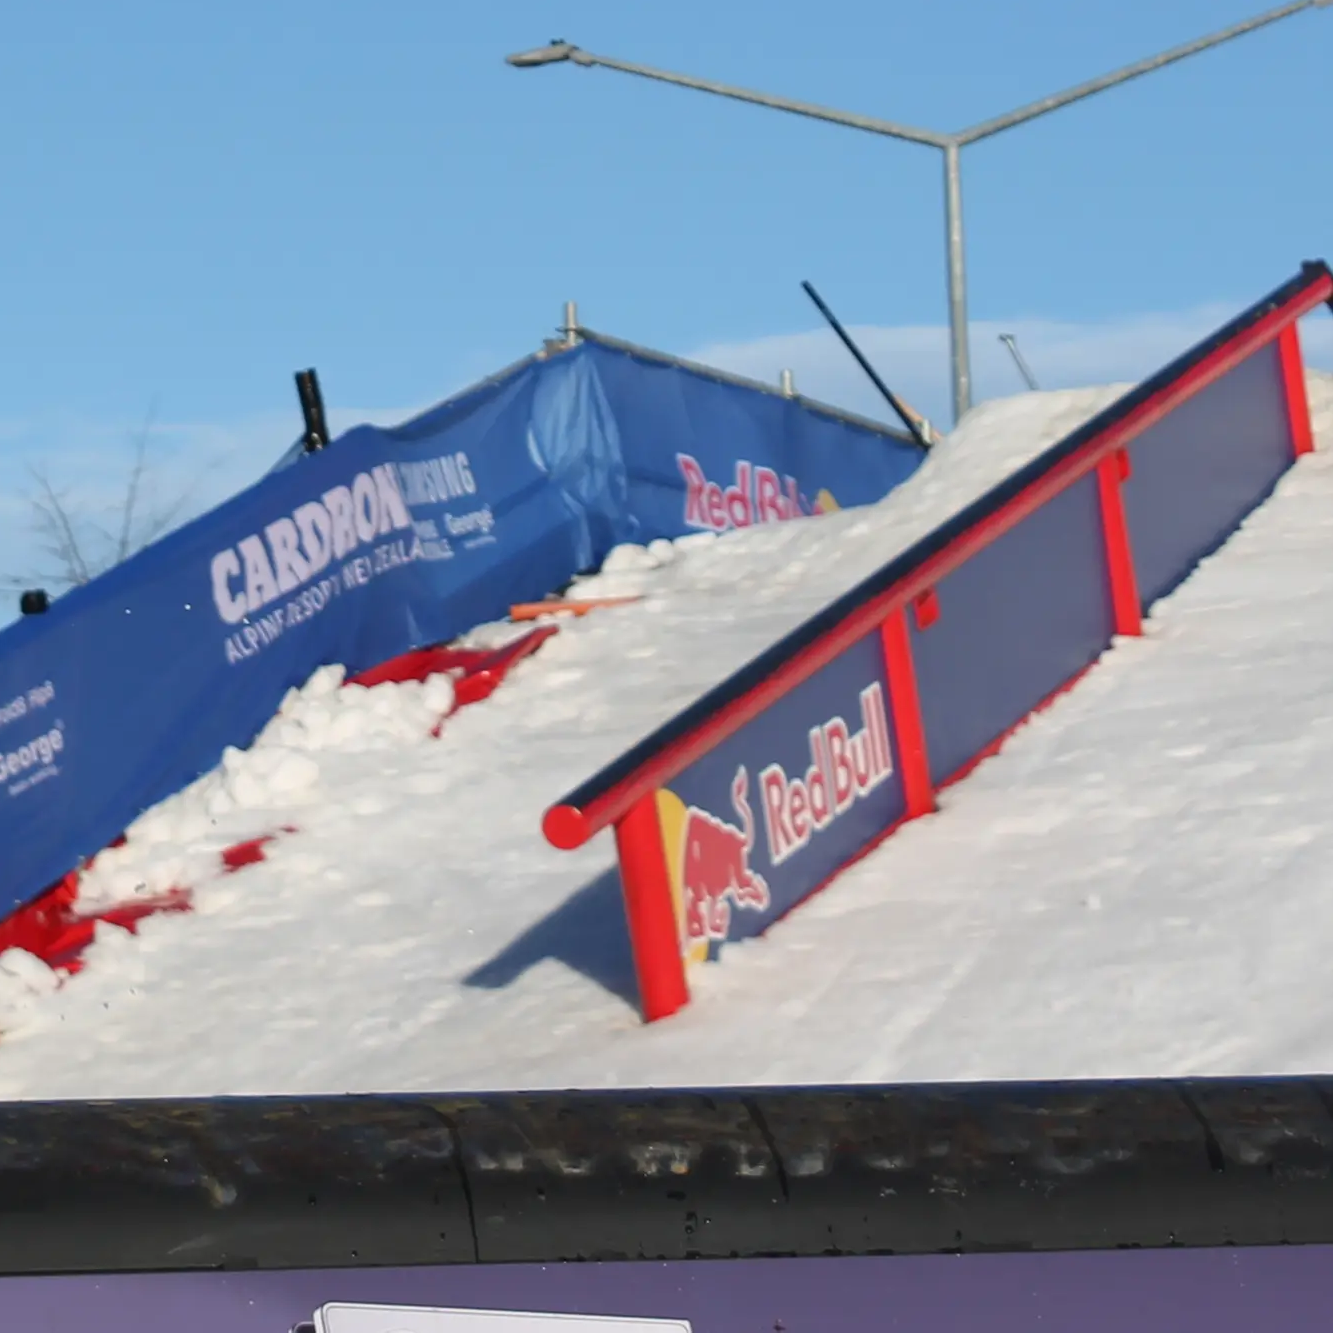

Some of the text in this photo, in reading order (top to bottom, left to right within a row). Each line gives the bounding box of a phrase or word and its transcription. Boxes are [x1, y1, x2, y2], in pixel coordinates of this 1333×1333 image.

[211, 460, 414, 625] CARDRON
[758, 680, 893, 867] Red Bull
